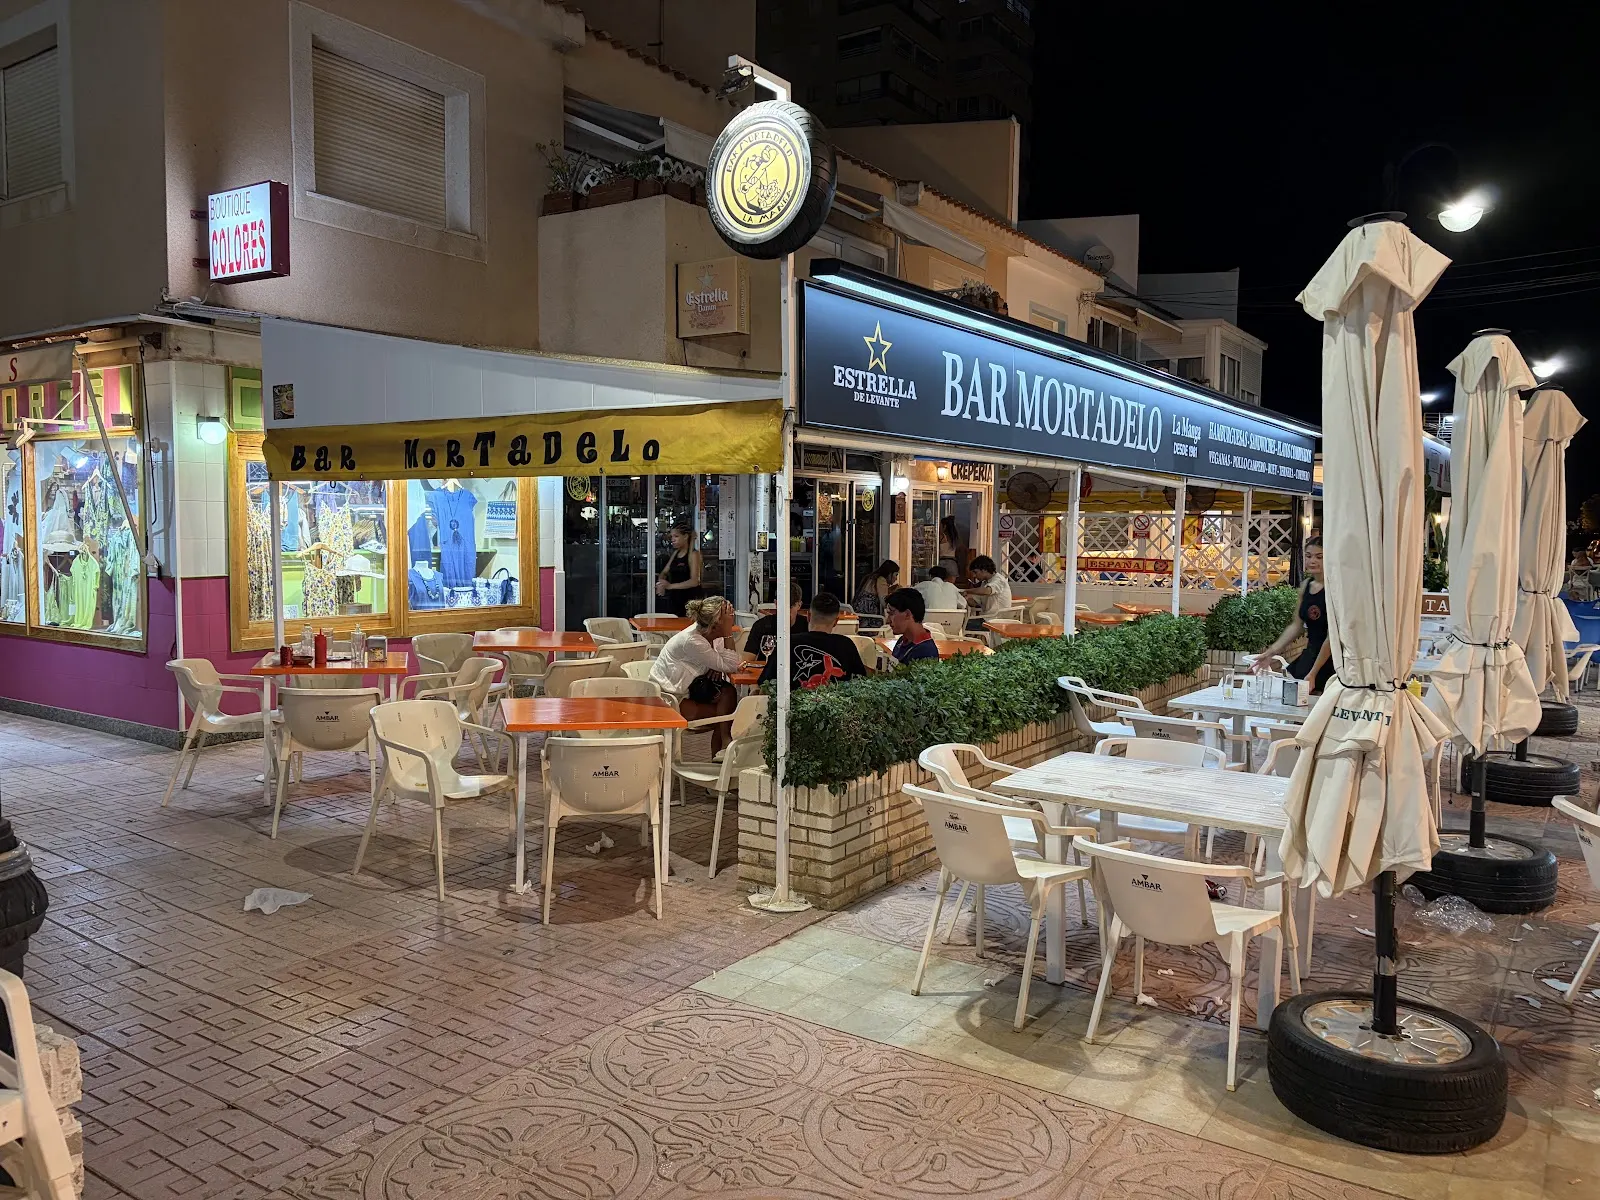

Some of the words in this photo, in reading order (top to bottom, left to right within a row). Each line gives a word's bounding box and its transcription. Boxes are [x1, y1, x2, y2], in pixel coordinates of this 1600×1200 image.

[210, 191, 251, 220] BOUTIQUE
[742, 213, 754, 224] LA
[211, 218, 266, 277] COLORES
[685, 288, 729, 306] Estrella
[833, 365, 918, 400] ESTRELLA
[853, 391, 866, 403] DE
[866, 392, 901, 409] LEVANTE
[941, 350, 1011, 426] BAR
[1015, 369, 1163, 454] MORTADELO
[1172, 414, 1181, 435] La
[1181, 415, 1202, 444] Manga
[1173, 441, 1189, 457] DESDE
[950, 462, 993, 483] CREPERIA
[1089, 560, 1142, 571] ESPAÑA
[944, 821, 969, 833] AMBAR
[1131, 877, 1162, 891] AMBAR
